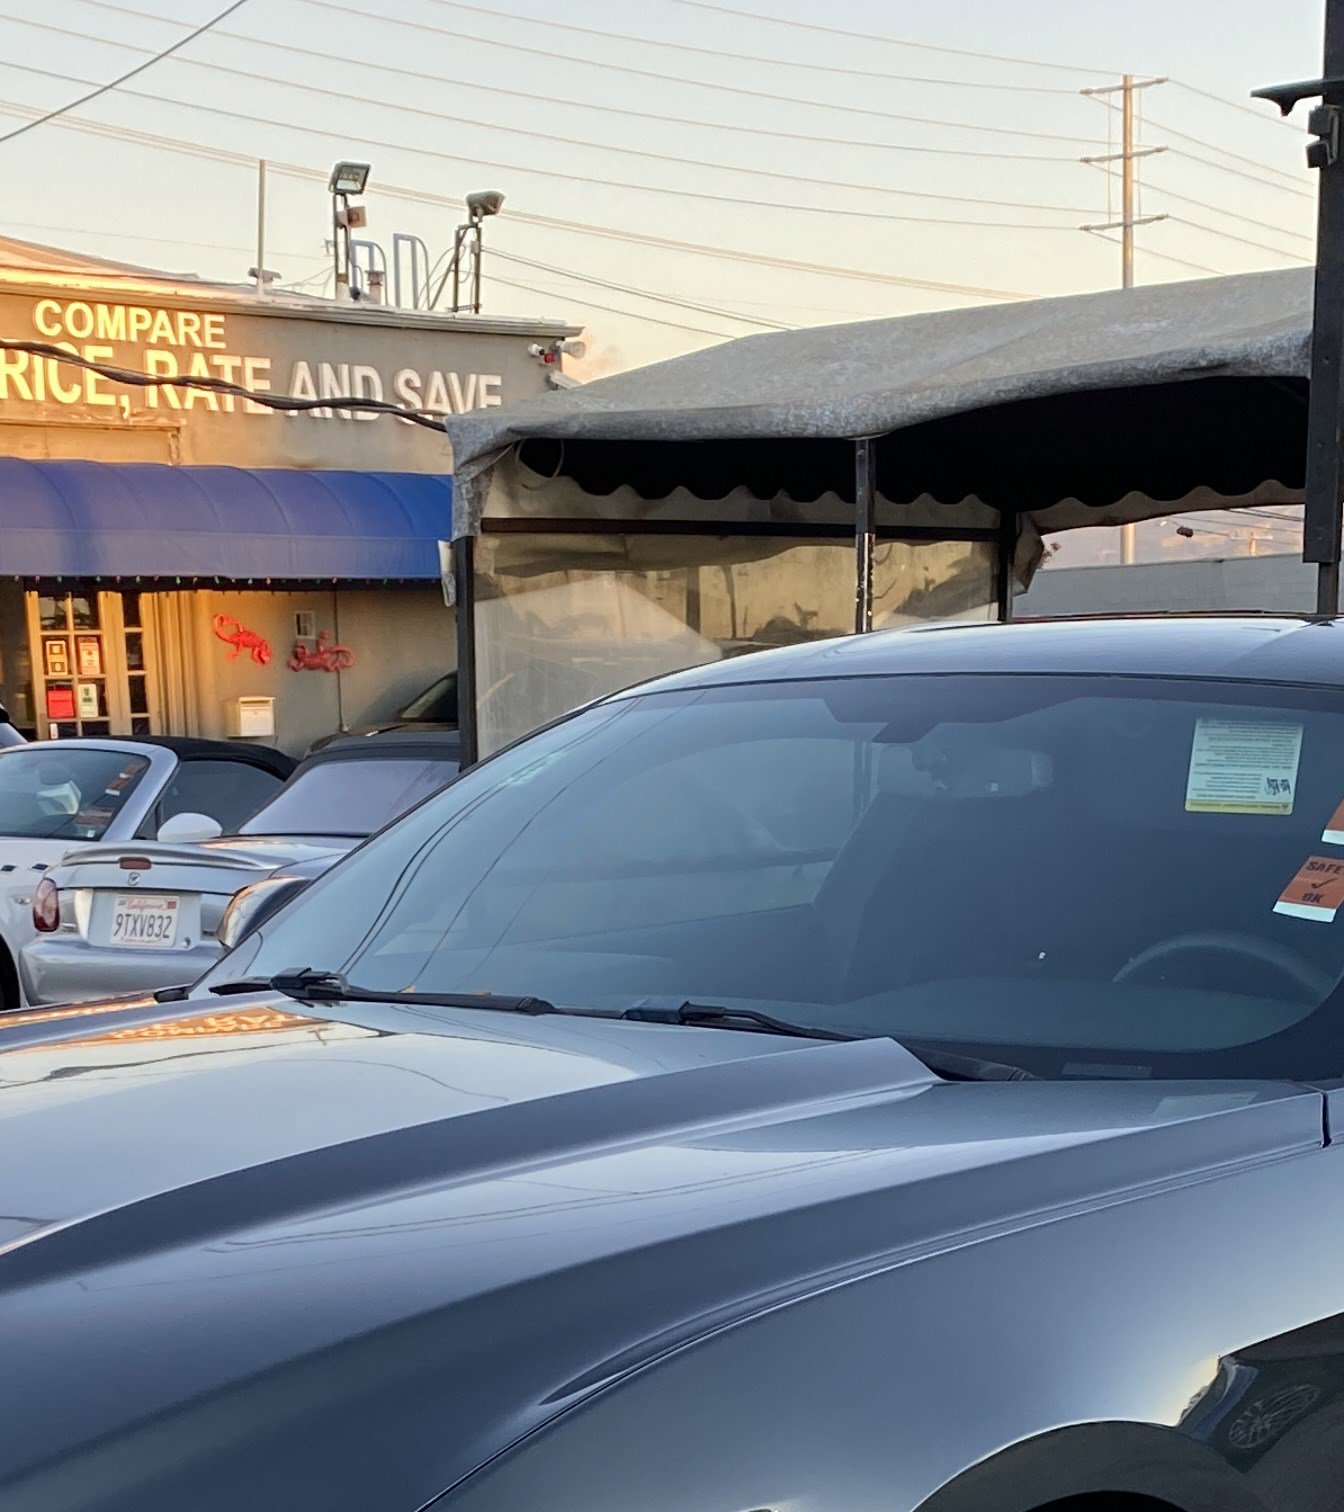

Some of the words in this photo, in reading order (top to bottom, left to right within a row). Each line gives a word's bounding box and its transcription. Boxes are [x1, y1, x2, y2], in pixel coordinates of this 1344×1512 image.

[35, 299, 226, 349] COMPARE
[144, 348, 272, 415] RATE
[285, 360, 383, 419] AND
[393, 368, 502, 425] SAVE
[1302, 893, 1325, 903] OK
[113, 914, 173, 938] 9TXV832
